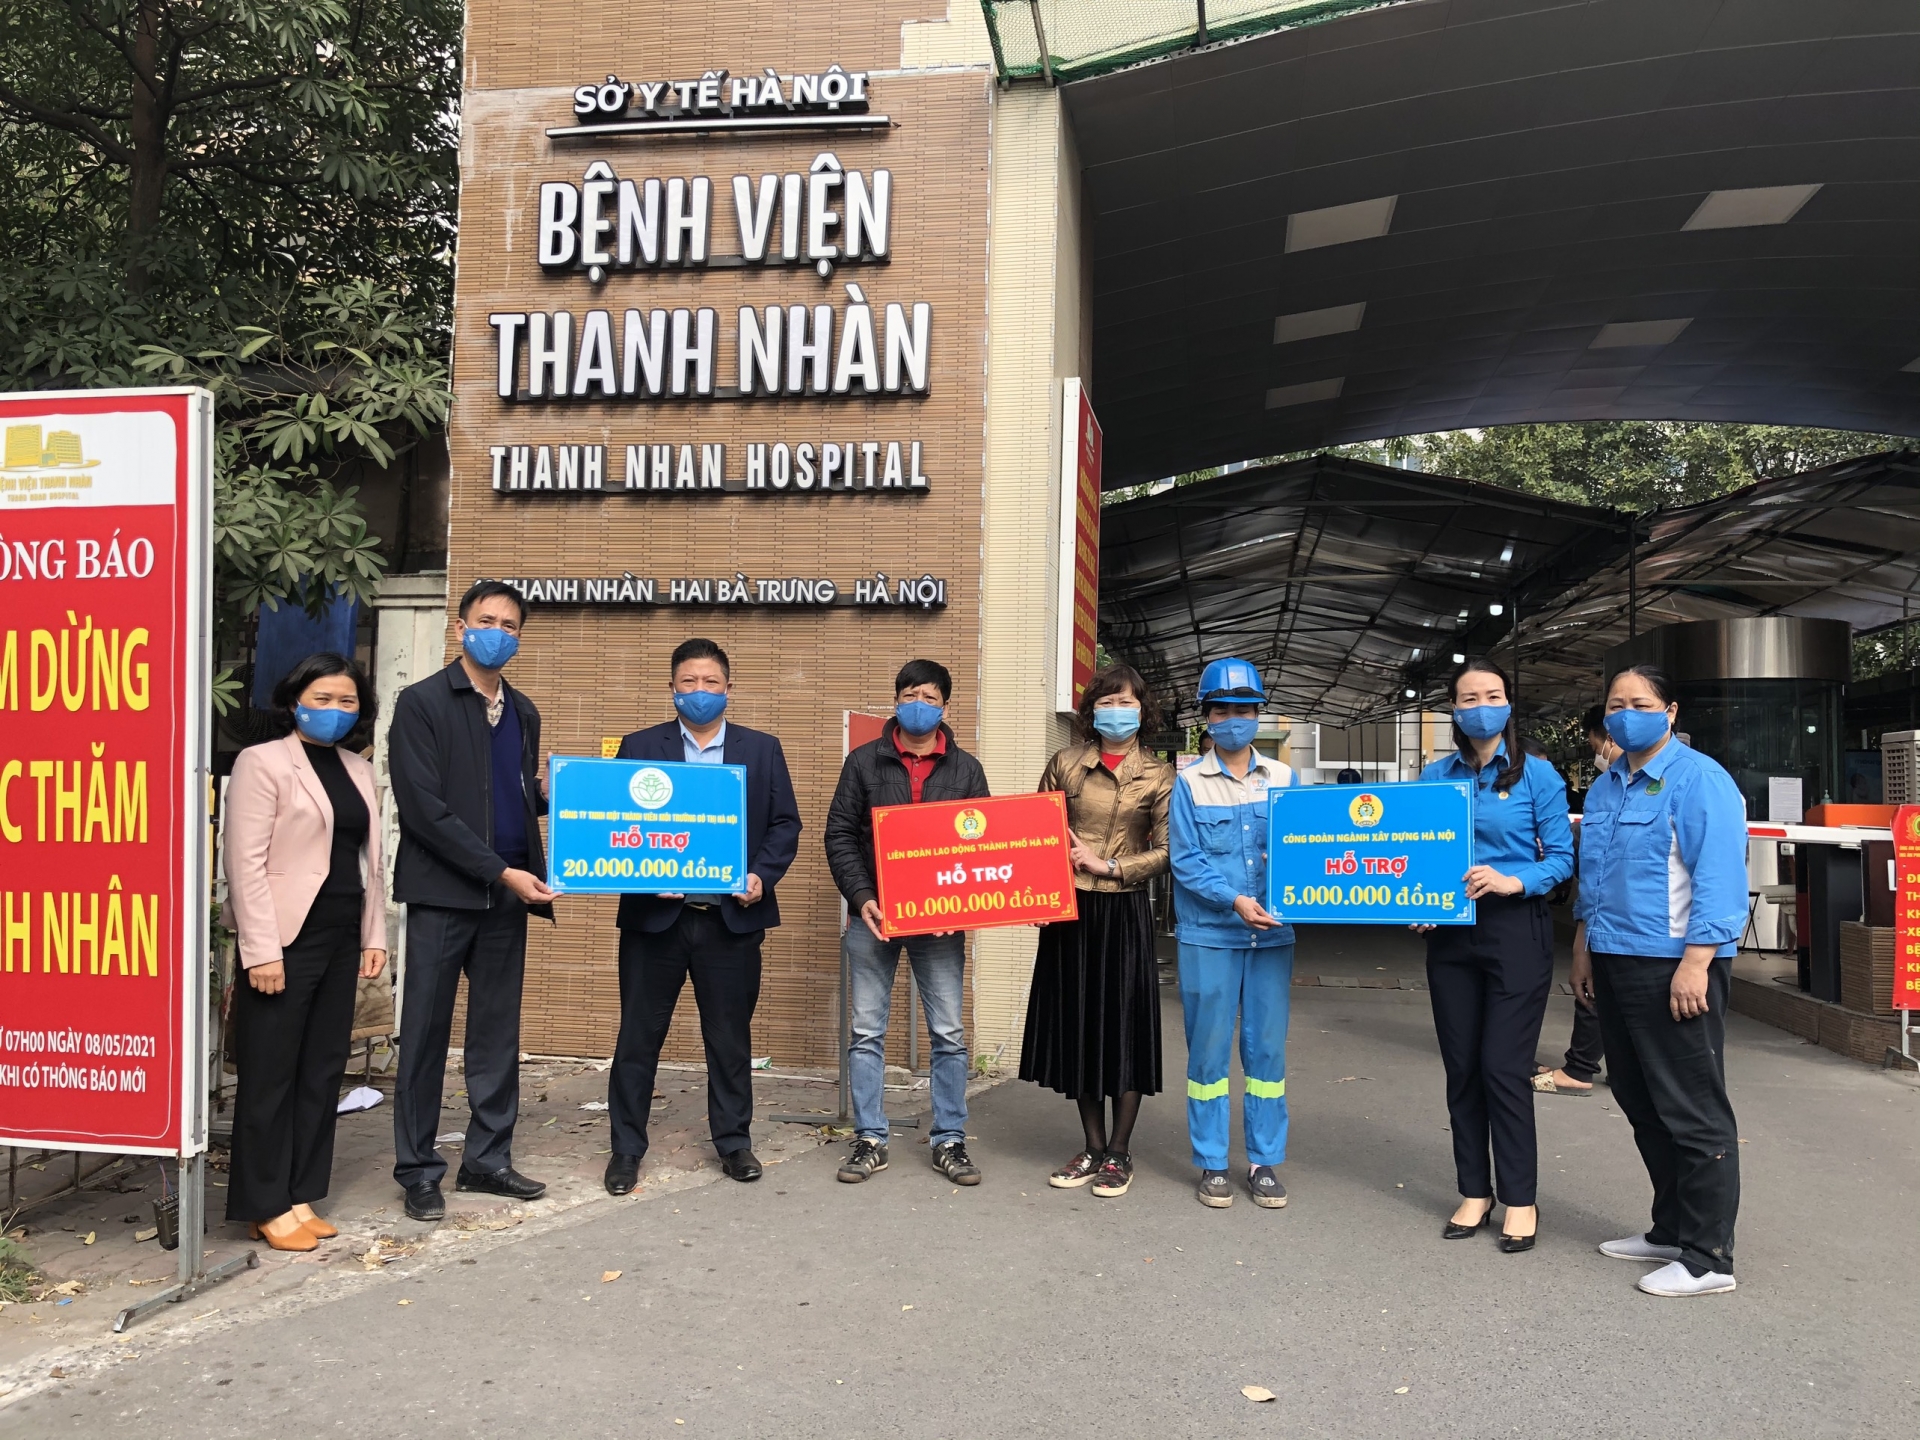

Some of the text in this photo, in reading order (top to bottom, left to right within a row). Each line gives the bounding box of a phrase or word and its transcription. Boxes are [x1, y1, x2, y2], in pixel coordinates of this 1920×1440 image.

[574, 64, 867, 114] SỞ Y TẾ HÀ NỘI
[539, 153, 891, 283] BỆNH VIỆN
[489, 282, 931, 399] THANH NHÀN
[490, 441, 928, 491] THANH NHAN HOSPITAL
[76, 528, 154, 579] BÁO
[585, 572, 654, 601] NHÀN
[670, 579, 711, 601] HAI
[718, 571, 749, 601] BÀ
[757, 578, 836, 602] TRƯNG
[855, 571, 891, 601] HÀ
[899, 574, 946, 608] NỘI
[30, 610, 150, 712] DỪNG
[30, 741, 147, 843] THĂM
[559, 809, 578, 819] CÔNG
[610, 825, 690, 853] HỖ TRỢ
[887, 835, 1059, 861] LIÊN ĐOÀN LAO ĐỘNG THÀNH PHỐ HÀ NỘI
[1283, 828, 1456, 844] CÔNG ĐOÀN NGÀNH XÂY DỰNG HÀ NỘI
[563, 857, 733, 882] 20.000.000 đồng
[937, 863, 1013, 886] HỖ TRỢ
[1325, 850, 1408, 878] HỖ TRỢ
[895, 886, 1061, 920] 10.000.000 đồng
[1282, 882, 1456, 910] 5.000.000 đồng
[43, 874, 158, 977] NHÂN
[5, 1030, 45, 1053] 07H00
[47, 1027, 82, 1054] NGÀY
[85, 1033, 156, 1058] 08/05/2021
[0, 1061, 146, 1093] KHI CÓ THÔNG BÁO MỚI
